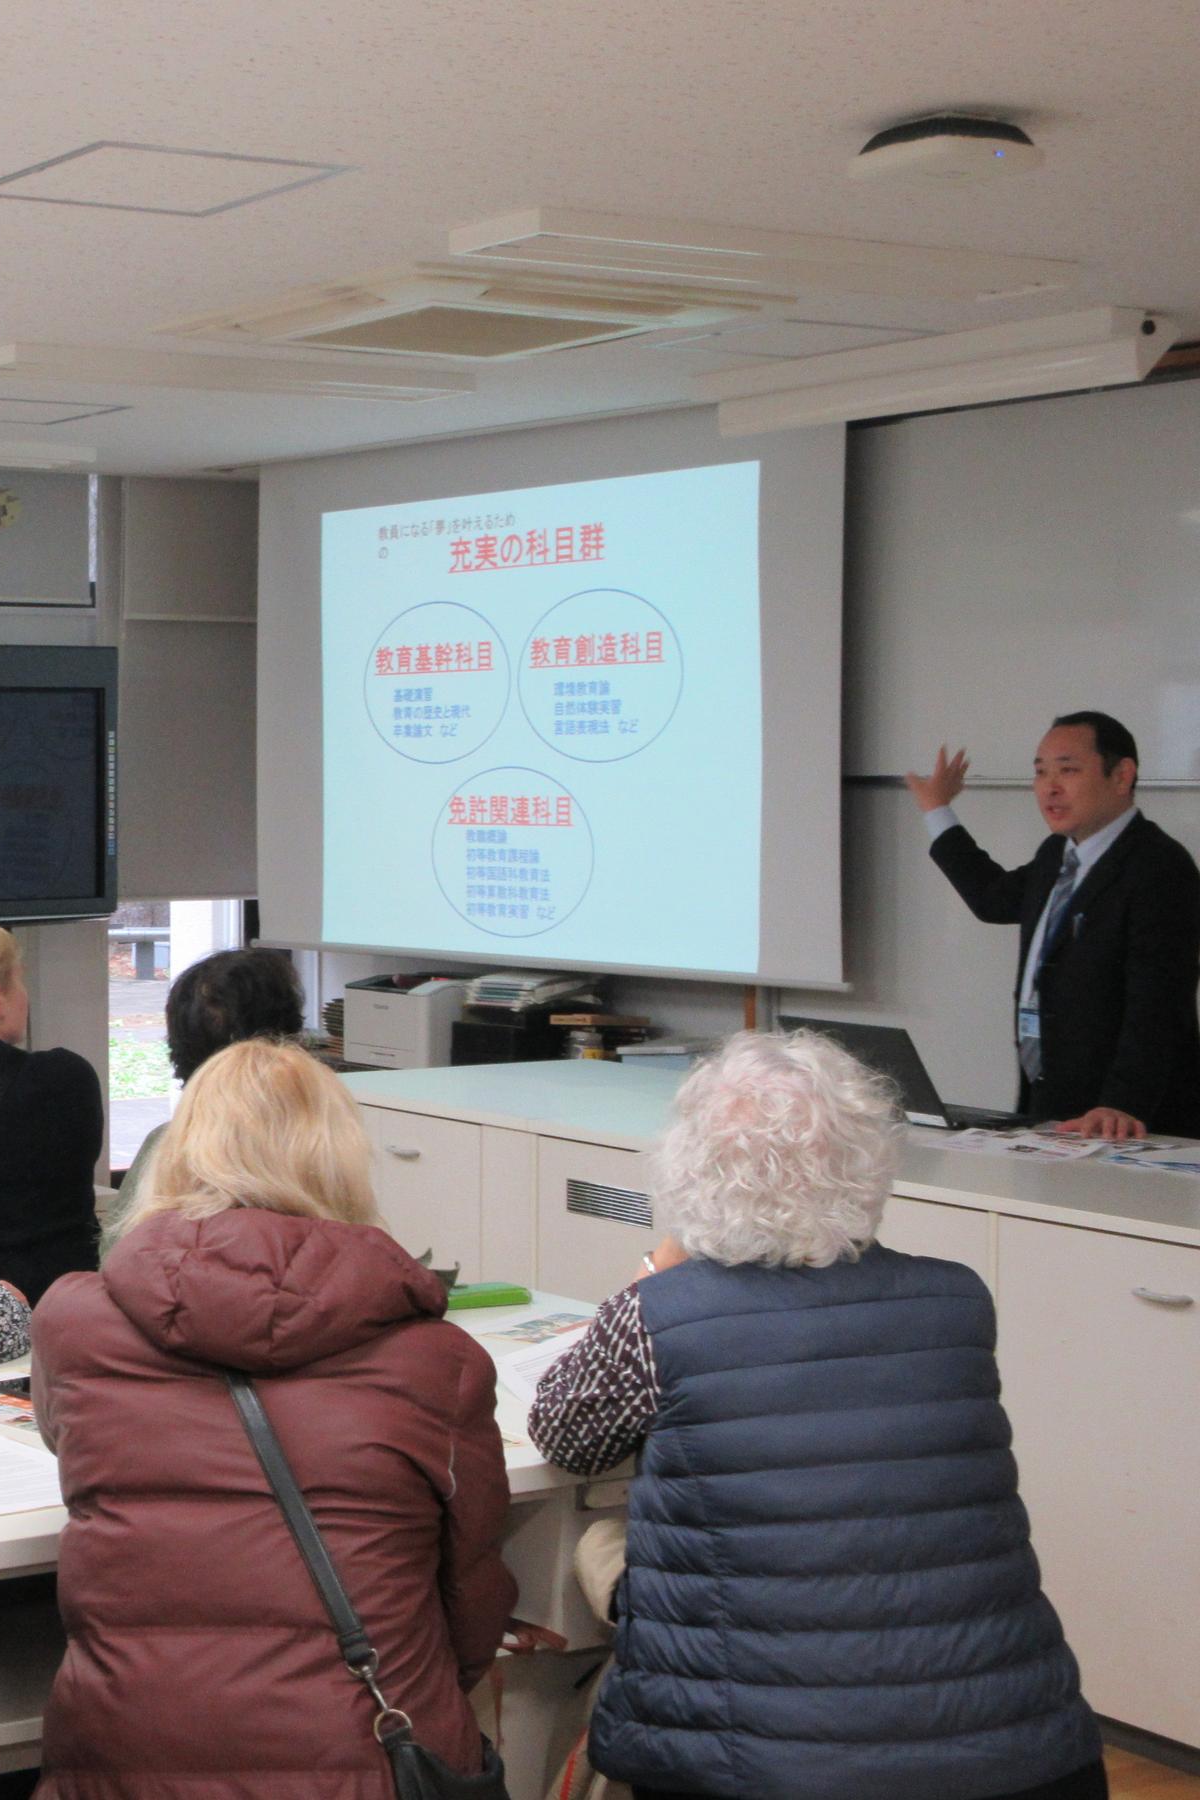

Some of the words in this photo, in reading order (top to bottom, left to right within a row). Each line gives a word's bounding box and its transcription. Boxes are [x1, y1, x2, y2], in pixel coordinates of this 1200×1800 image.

[449, 522, 605, 572] 充実の科目群
[375, 641, 493, 674] 教育基幹科目
[529, 631, 663, 668] 教育創造科目
[448, 796, 573, 826] 免許関連科目
